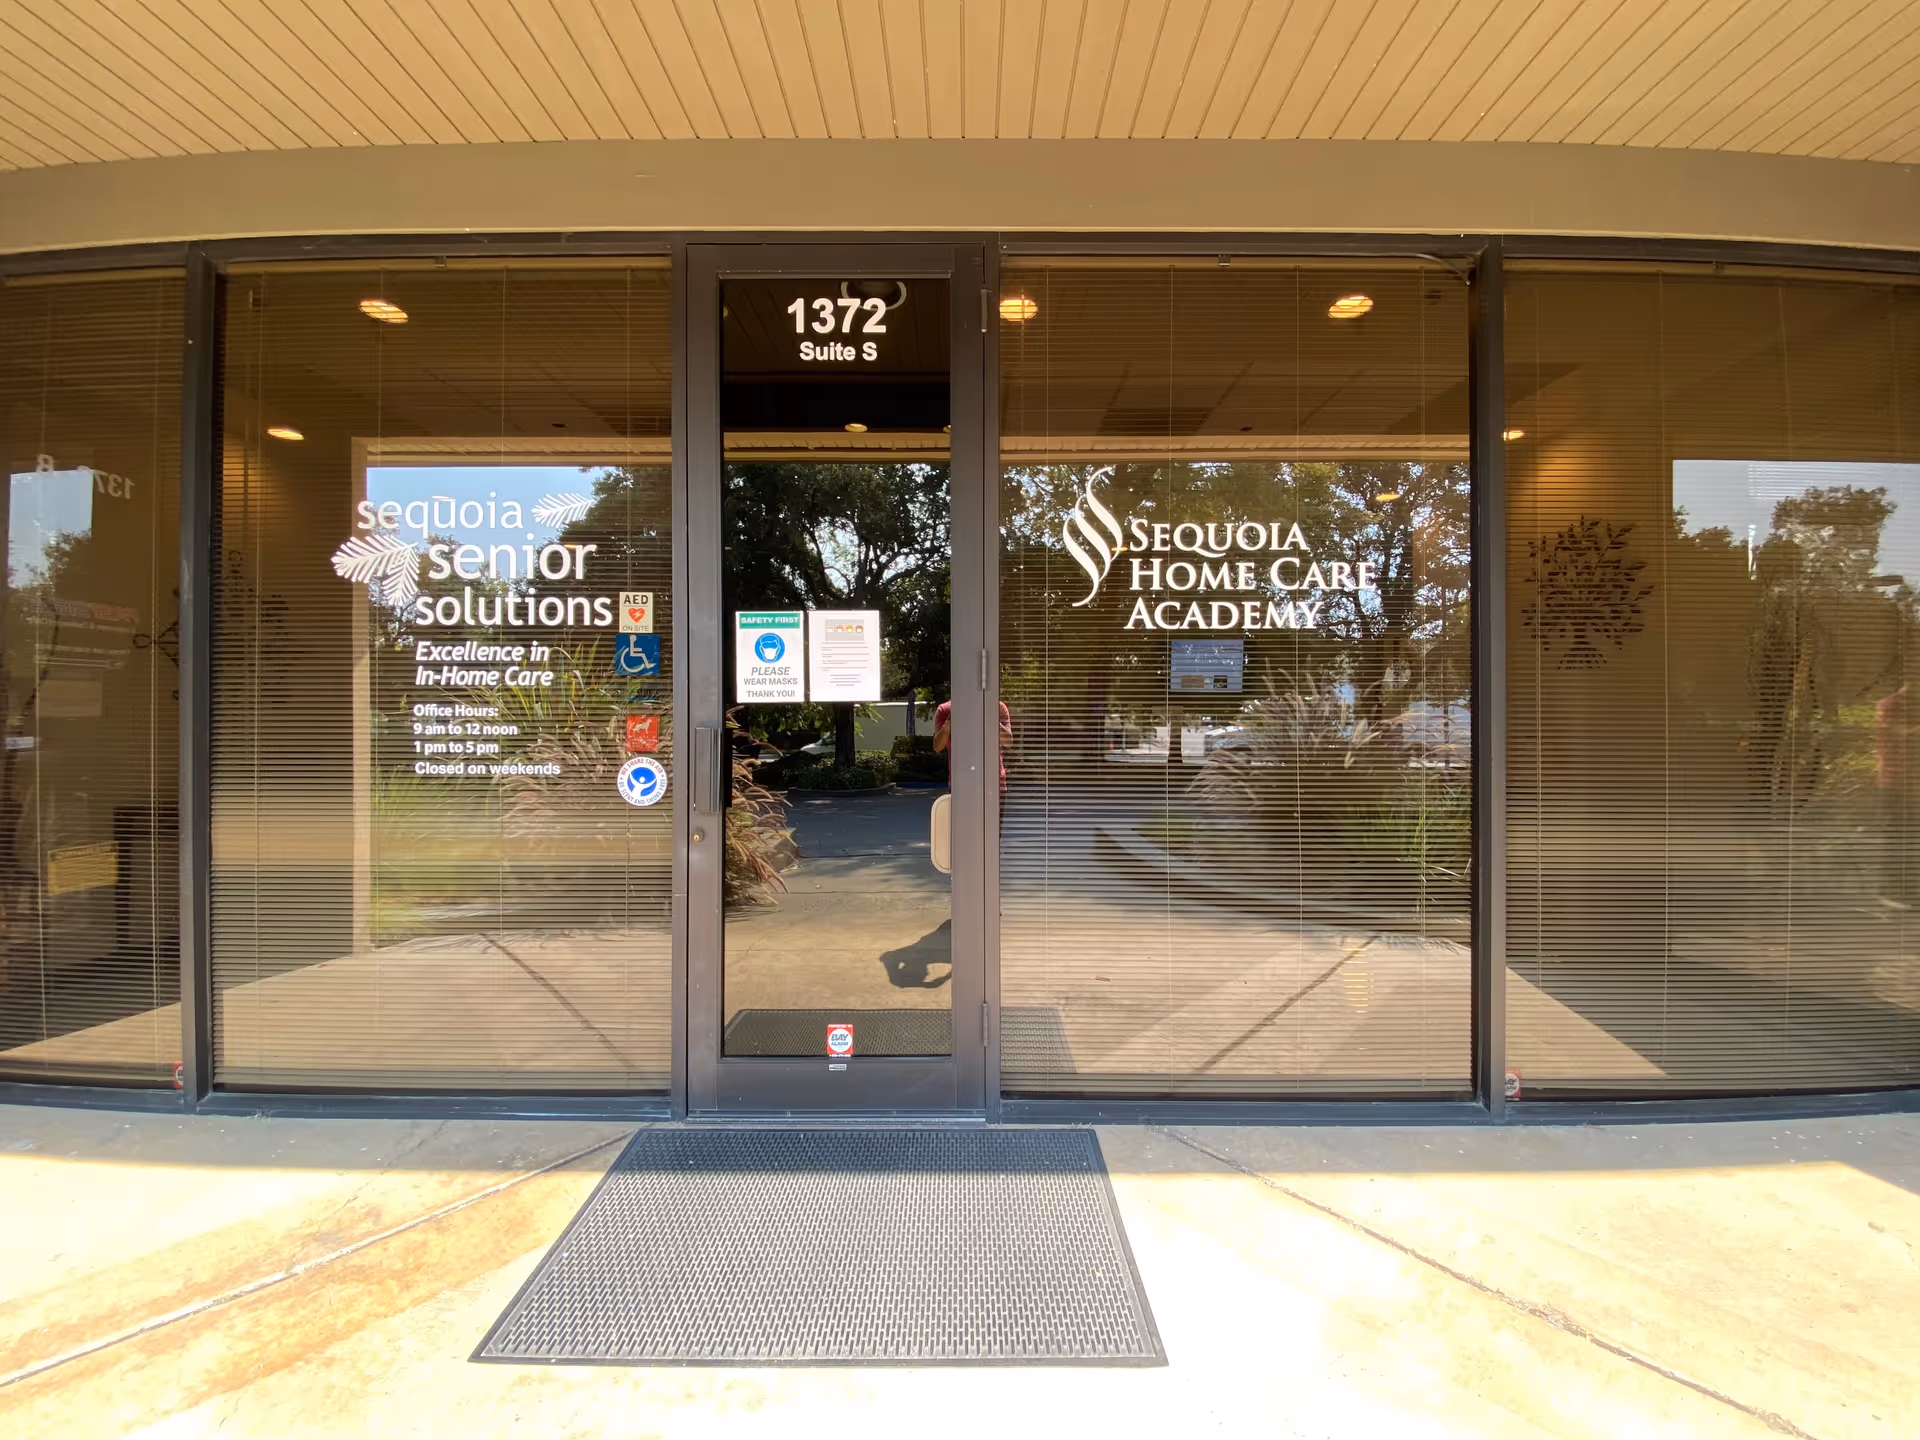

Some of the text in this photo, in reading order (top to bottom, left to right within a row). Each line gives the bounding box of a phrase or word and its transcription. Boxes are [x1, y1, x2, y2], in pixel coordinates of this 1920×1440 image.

[787, 297, 886, 334] 1372
[799, 341, 877, 361] Suite S
[1128, 518, 1309, 558] SEQUOIA
[428, 533, 597, 580] senior
[1129, 557, 1377, 591] HOME CARE
[415, 586, 613, 626] solutions
[623, 594, 649, 605] AED
[741, 616, 799, 624] SAFETY FIRST
[1124, 596, 1325, 630] ACADEMY
[415, 640, 549, 662] Excellence in
[415, 666, 554, 686] In-Home Care
[751, 666, 790, 675] PLEASE
[744, 677, 798, 685] WEAR MASKS
[746, 690, 775, 698] THANK
[413, 704, 499, 718] Office Hours:
[413, 723, 518, 735] 9 am to 12 noon
[414, 741, 499, 756] 1 pm to 5 pm
[415, 761, 561, 775] Closed on weekends
[626, 758, 644, 768] SHARE
[645, 758, 656, 767] THE
[654, 764, 664, 774] AIR
